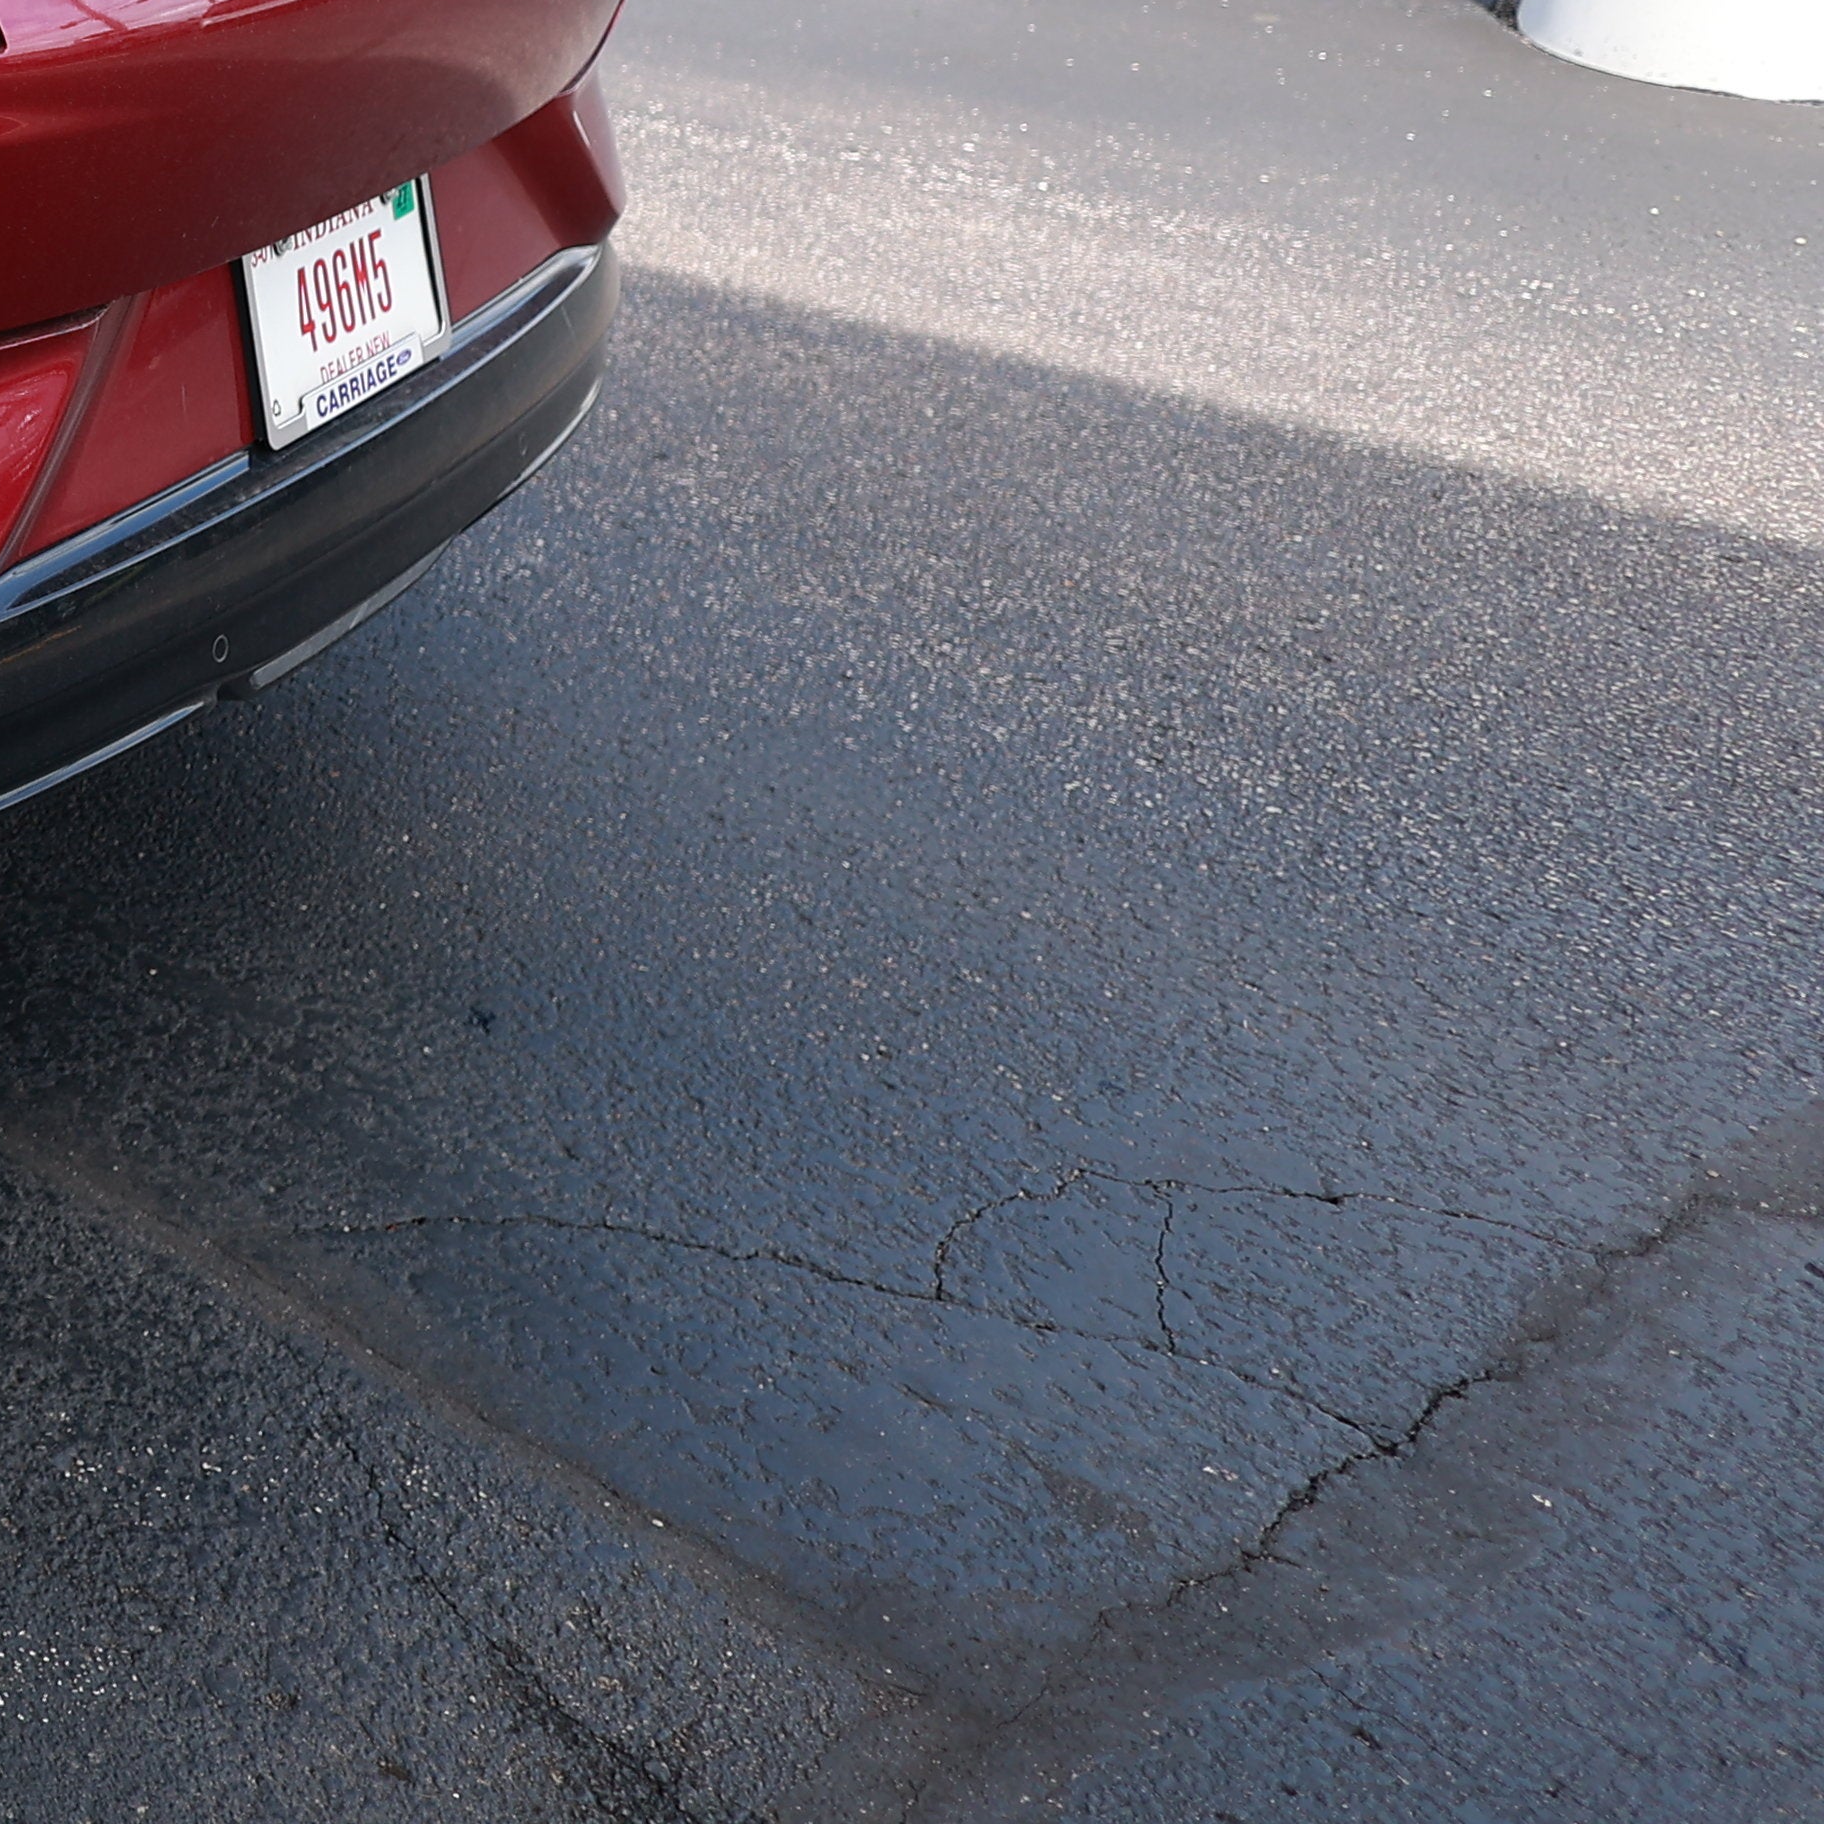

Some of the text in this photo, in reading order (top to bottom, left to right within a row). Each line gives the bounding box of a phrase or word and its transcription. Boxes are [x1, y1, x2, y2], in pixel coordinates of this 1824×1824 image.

[294, 199, 374, 250] INDIANA
[297, 228, 392, 352] 496M5
[316, 354, 397, 418] CARRIAGE
